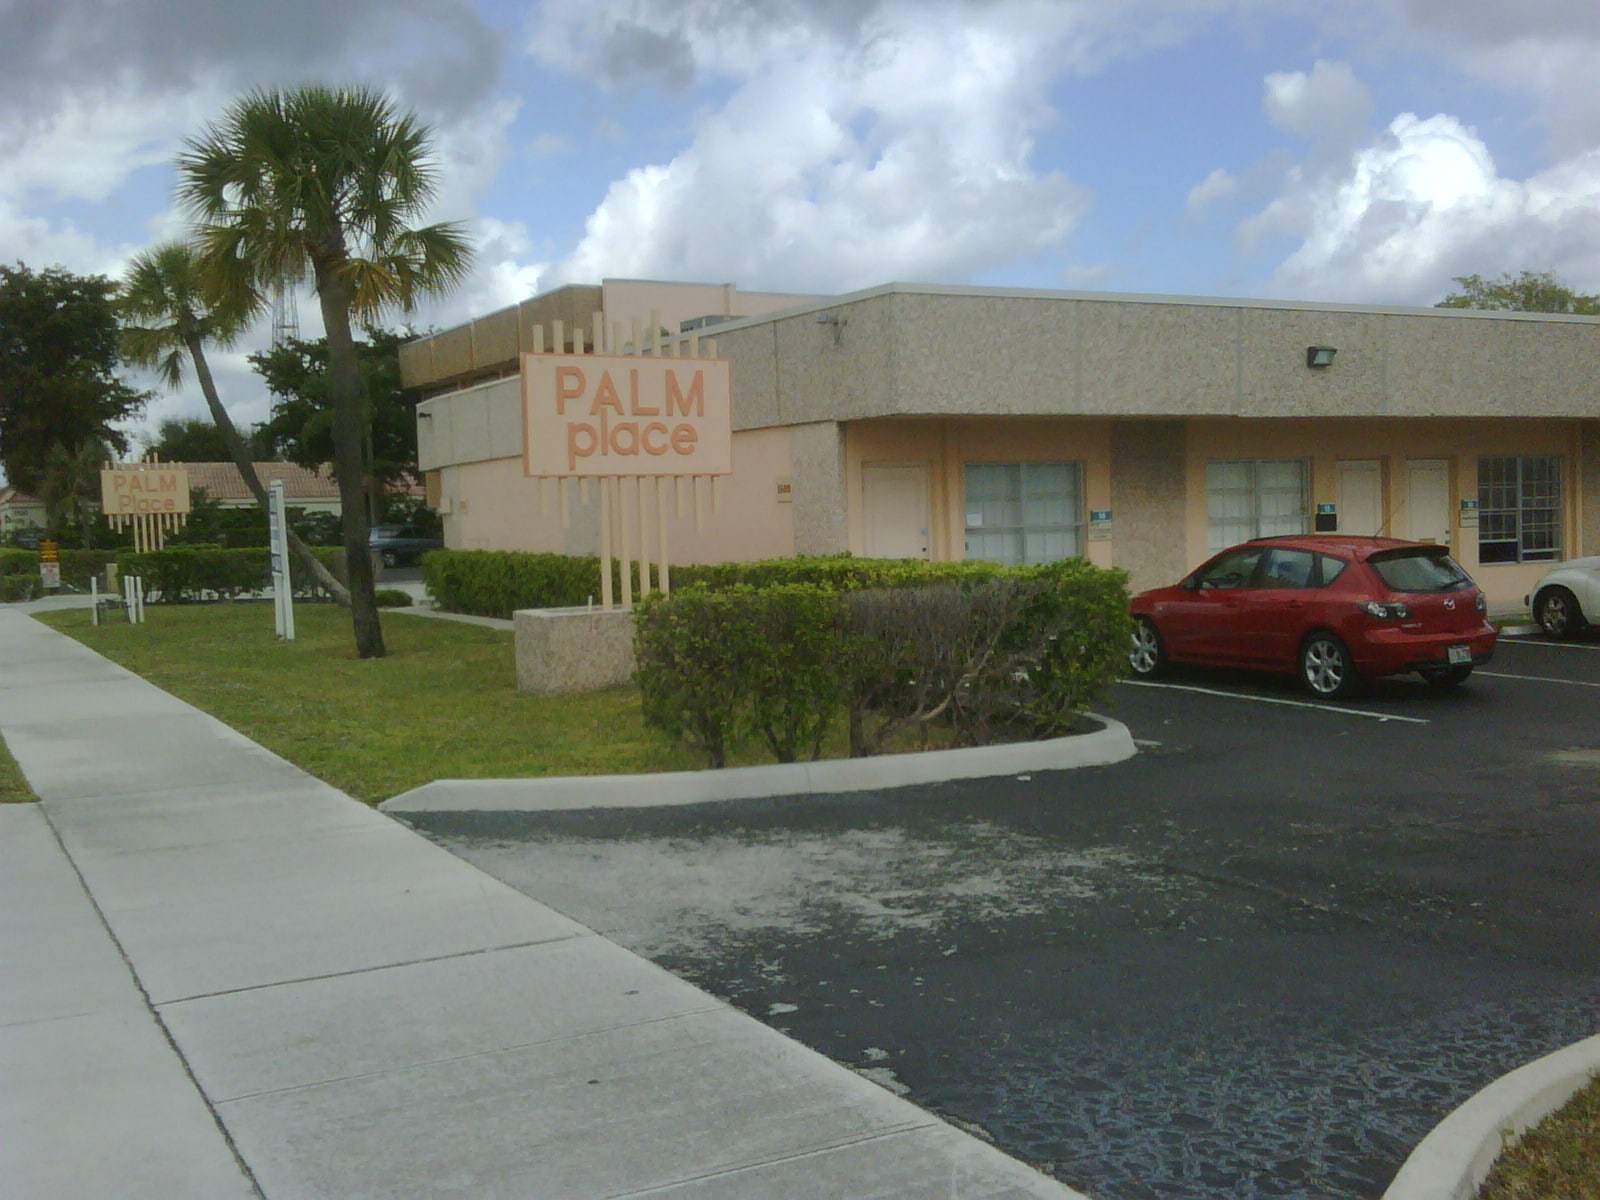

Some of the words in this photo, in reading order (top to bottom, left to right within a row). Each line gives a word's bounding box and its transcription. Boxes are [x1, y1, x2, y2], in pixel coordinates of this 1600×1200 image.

[556, 366, 704, 417] PALM
[567, 407, 698, 471] place
[112, 474, 177, 492] PALM
